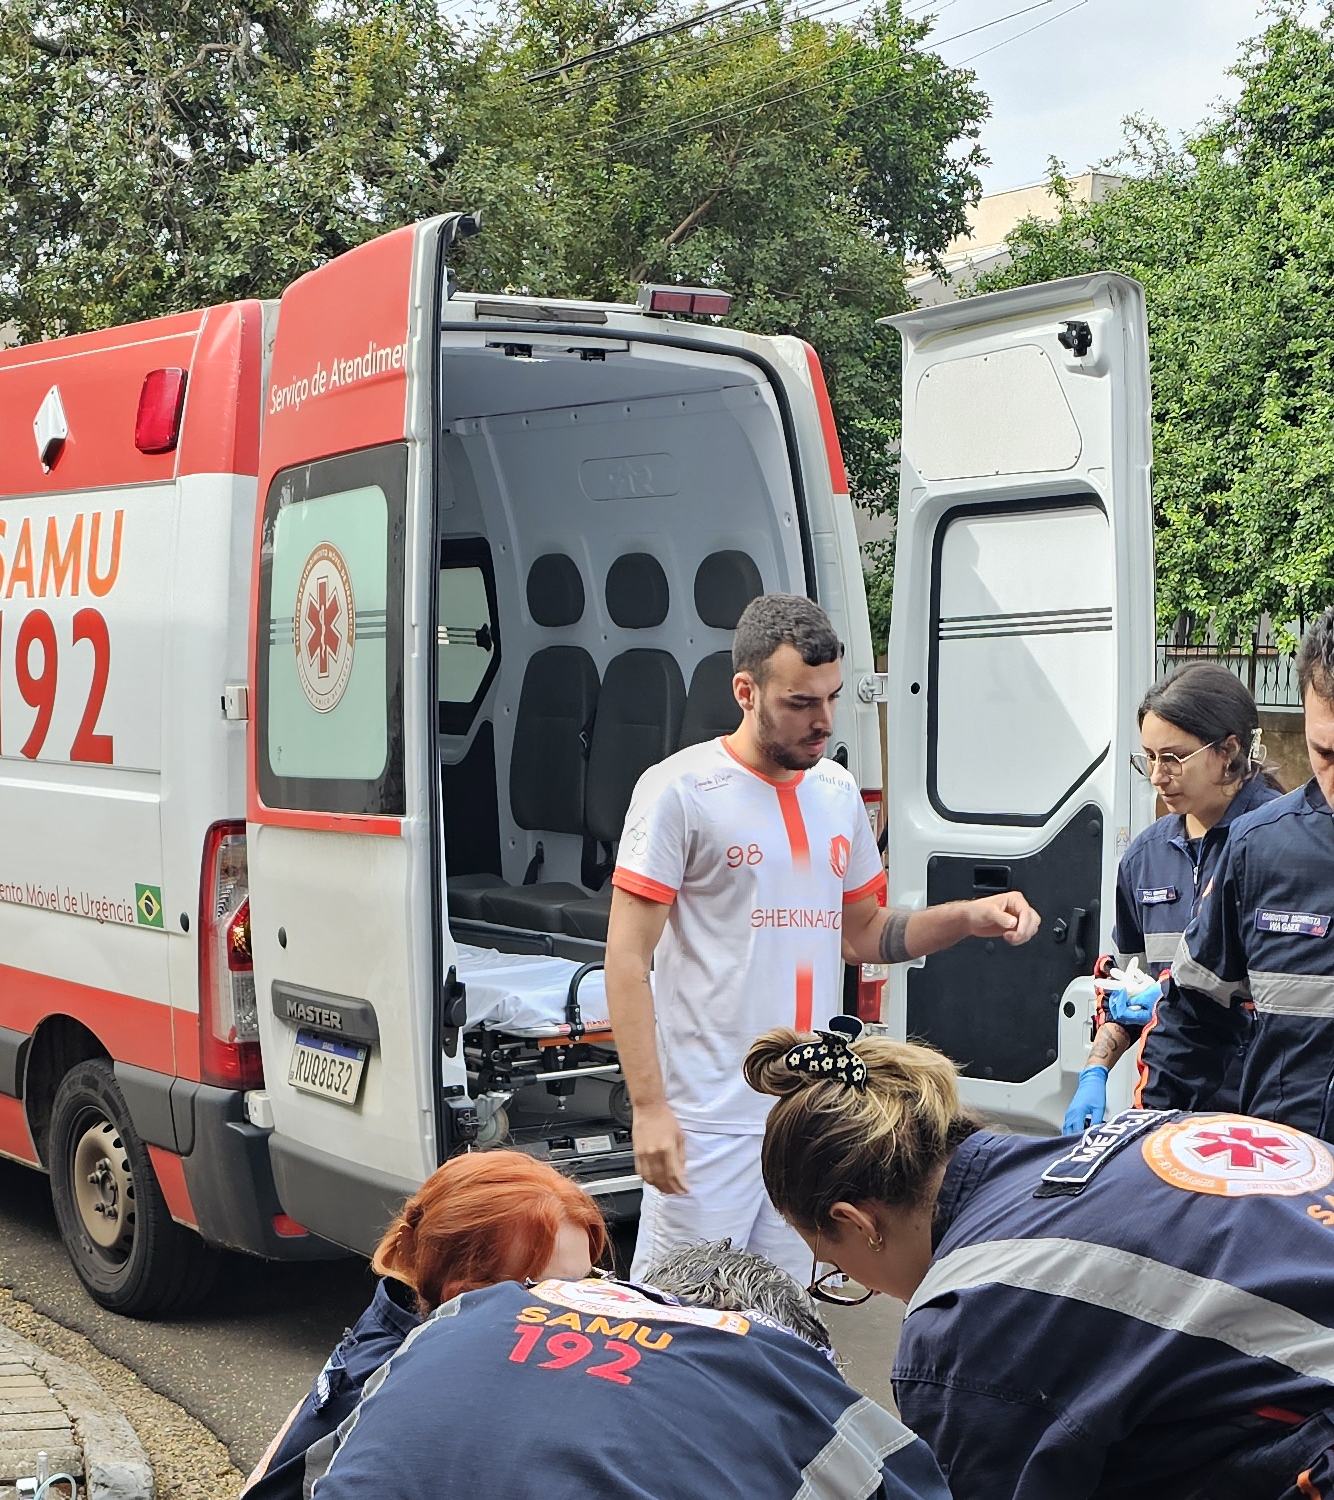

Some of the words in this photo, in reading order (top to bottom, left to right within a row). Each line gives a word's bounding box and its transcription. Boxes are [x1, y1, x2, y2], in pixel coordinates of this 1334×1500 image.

[269, 375, 309, 415] Serviço
[311, 361, 327, 396] de
[727, 843, 763, 869] 98
[26, 882, 61, 912] Móvel
[64, 887, 78, 914] de
[80, 892, 135, 925] Urgência
[286, 1000, 343, 1029] MASTER
[295, 1049, 353, 1096] RUQ8G32
[517, 1306, 674, 1351] SAMU
[508, 1324, 642, 1385] 192
